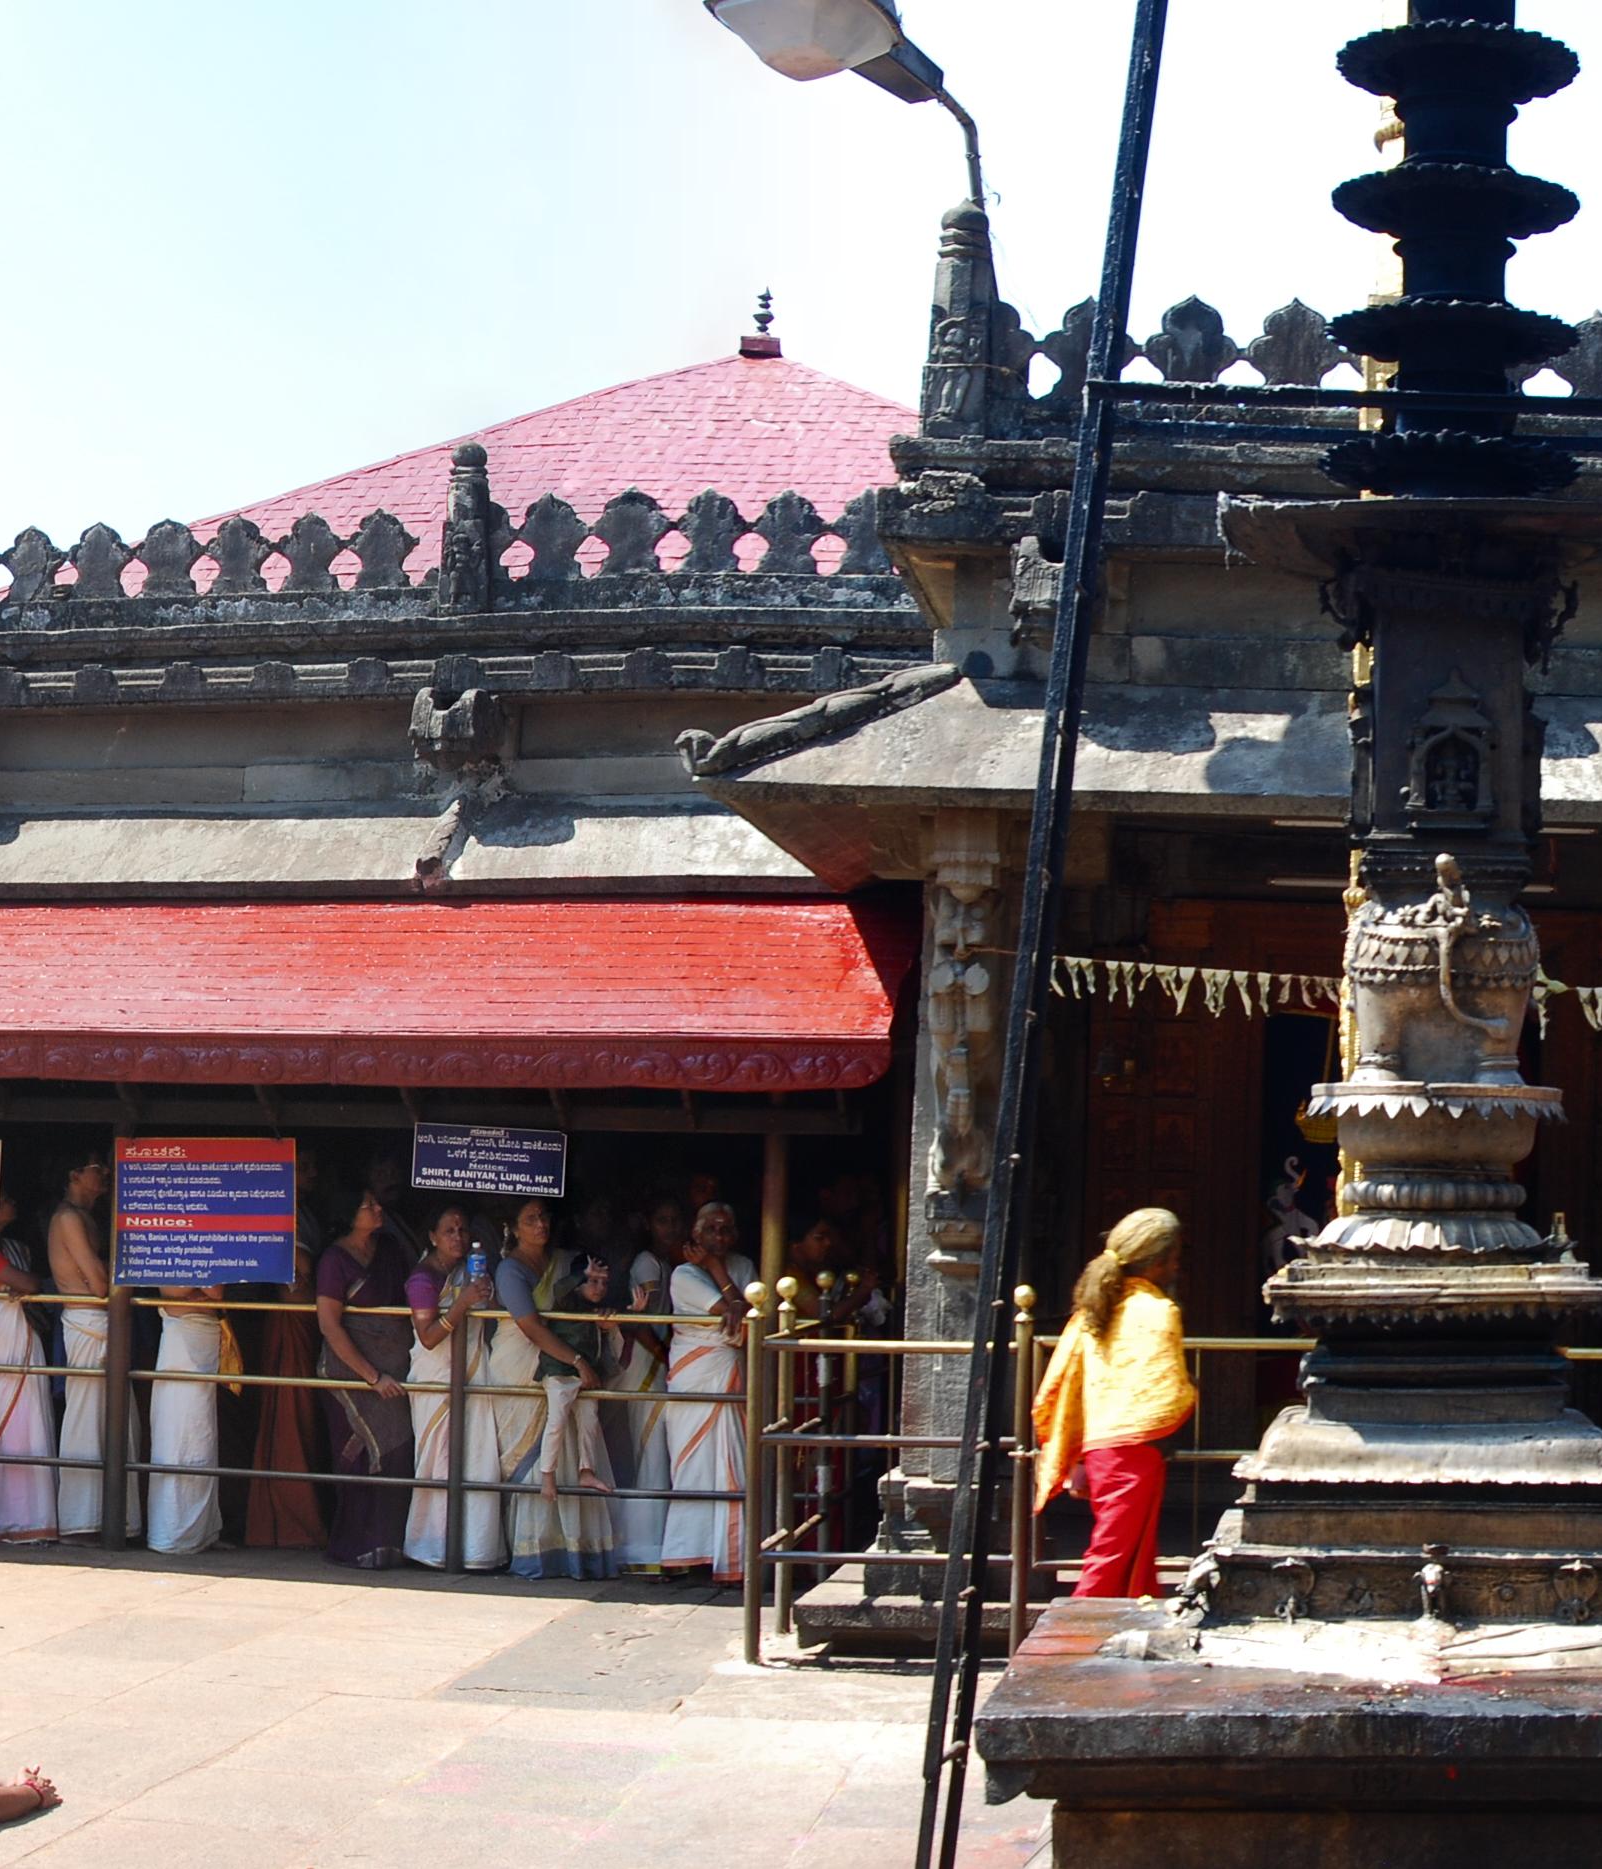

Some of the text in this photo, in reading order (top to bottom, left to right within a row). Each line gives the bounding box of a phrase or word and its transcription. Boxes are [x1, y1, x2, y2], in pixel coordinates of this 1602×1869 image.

[469, 1162, 508, 1171] Notice:
[421, 1167, 554, 1184] SHIRT, BANIYAN, LUNGI, HAT
[415, 1177, 559, 1195] Prohibited in Side the Premises
[125, 1217, 194, 1227] Notice:
[148, 1233, 169, 1242] Banian,
[170, 1233, 187, 1243] Lungi,
[188, 1233, 199, 1241] Hat
[199, 1233, 228, 1243] prohibited
[235, 1233, 247, 1241] side
[248, 1233, 257, 1241] the
[164, 1246, 182, 1255] strictly
[184, 1246, 214, 1255] prohibited.
[128, 1258, 144, 1266] Video
[145, 1258, 166, 1266] Camera
[174, 1258, 191, 1266] Photo
[209, 1258, 238, 1267] prohibited
[127, 1270, 142, 1279] Keep
[143, 1270, 163, 1278] Silence
[164, 1270, 175, 1278] and
[176, 1270, 192, 1278] follow
